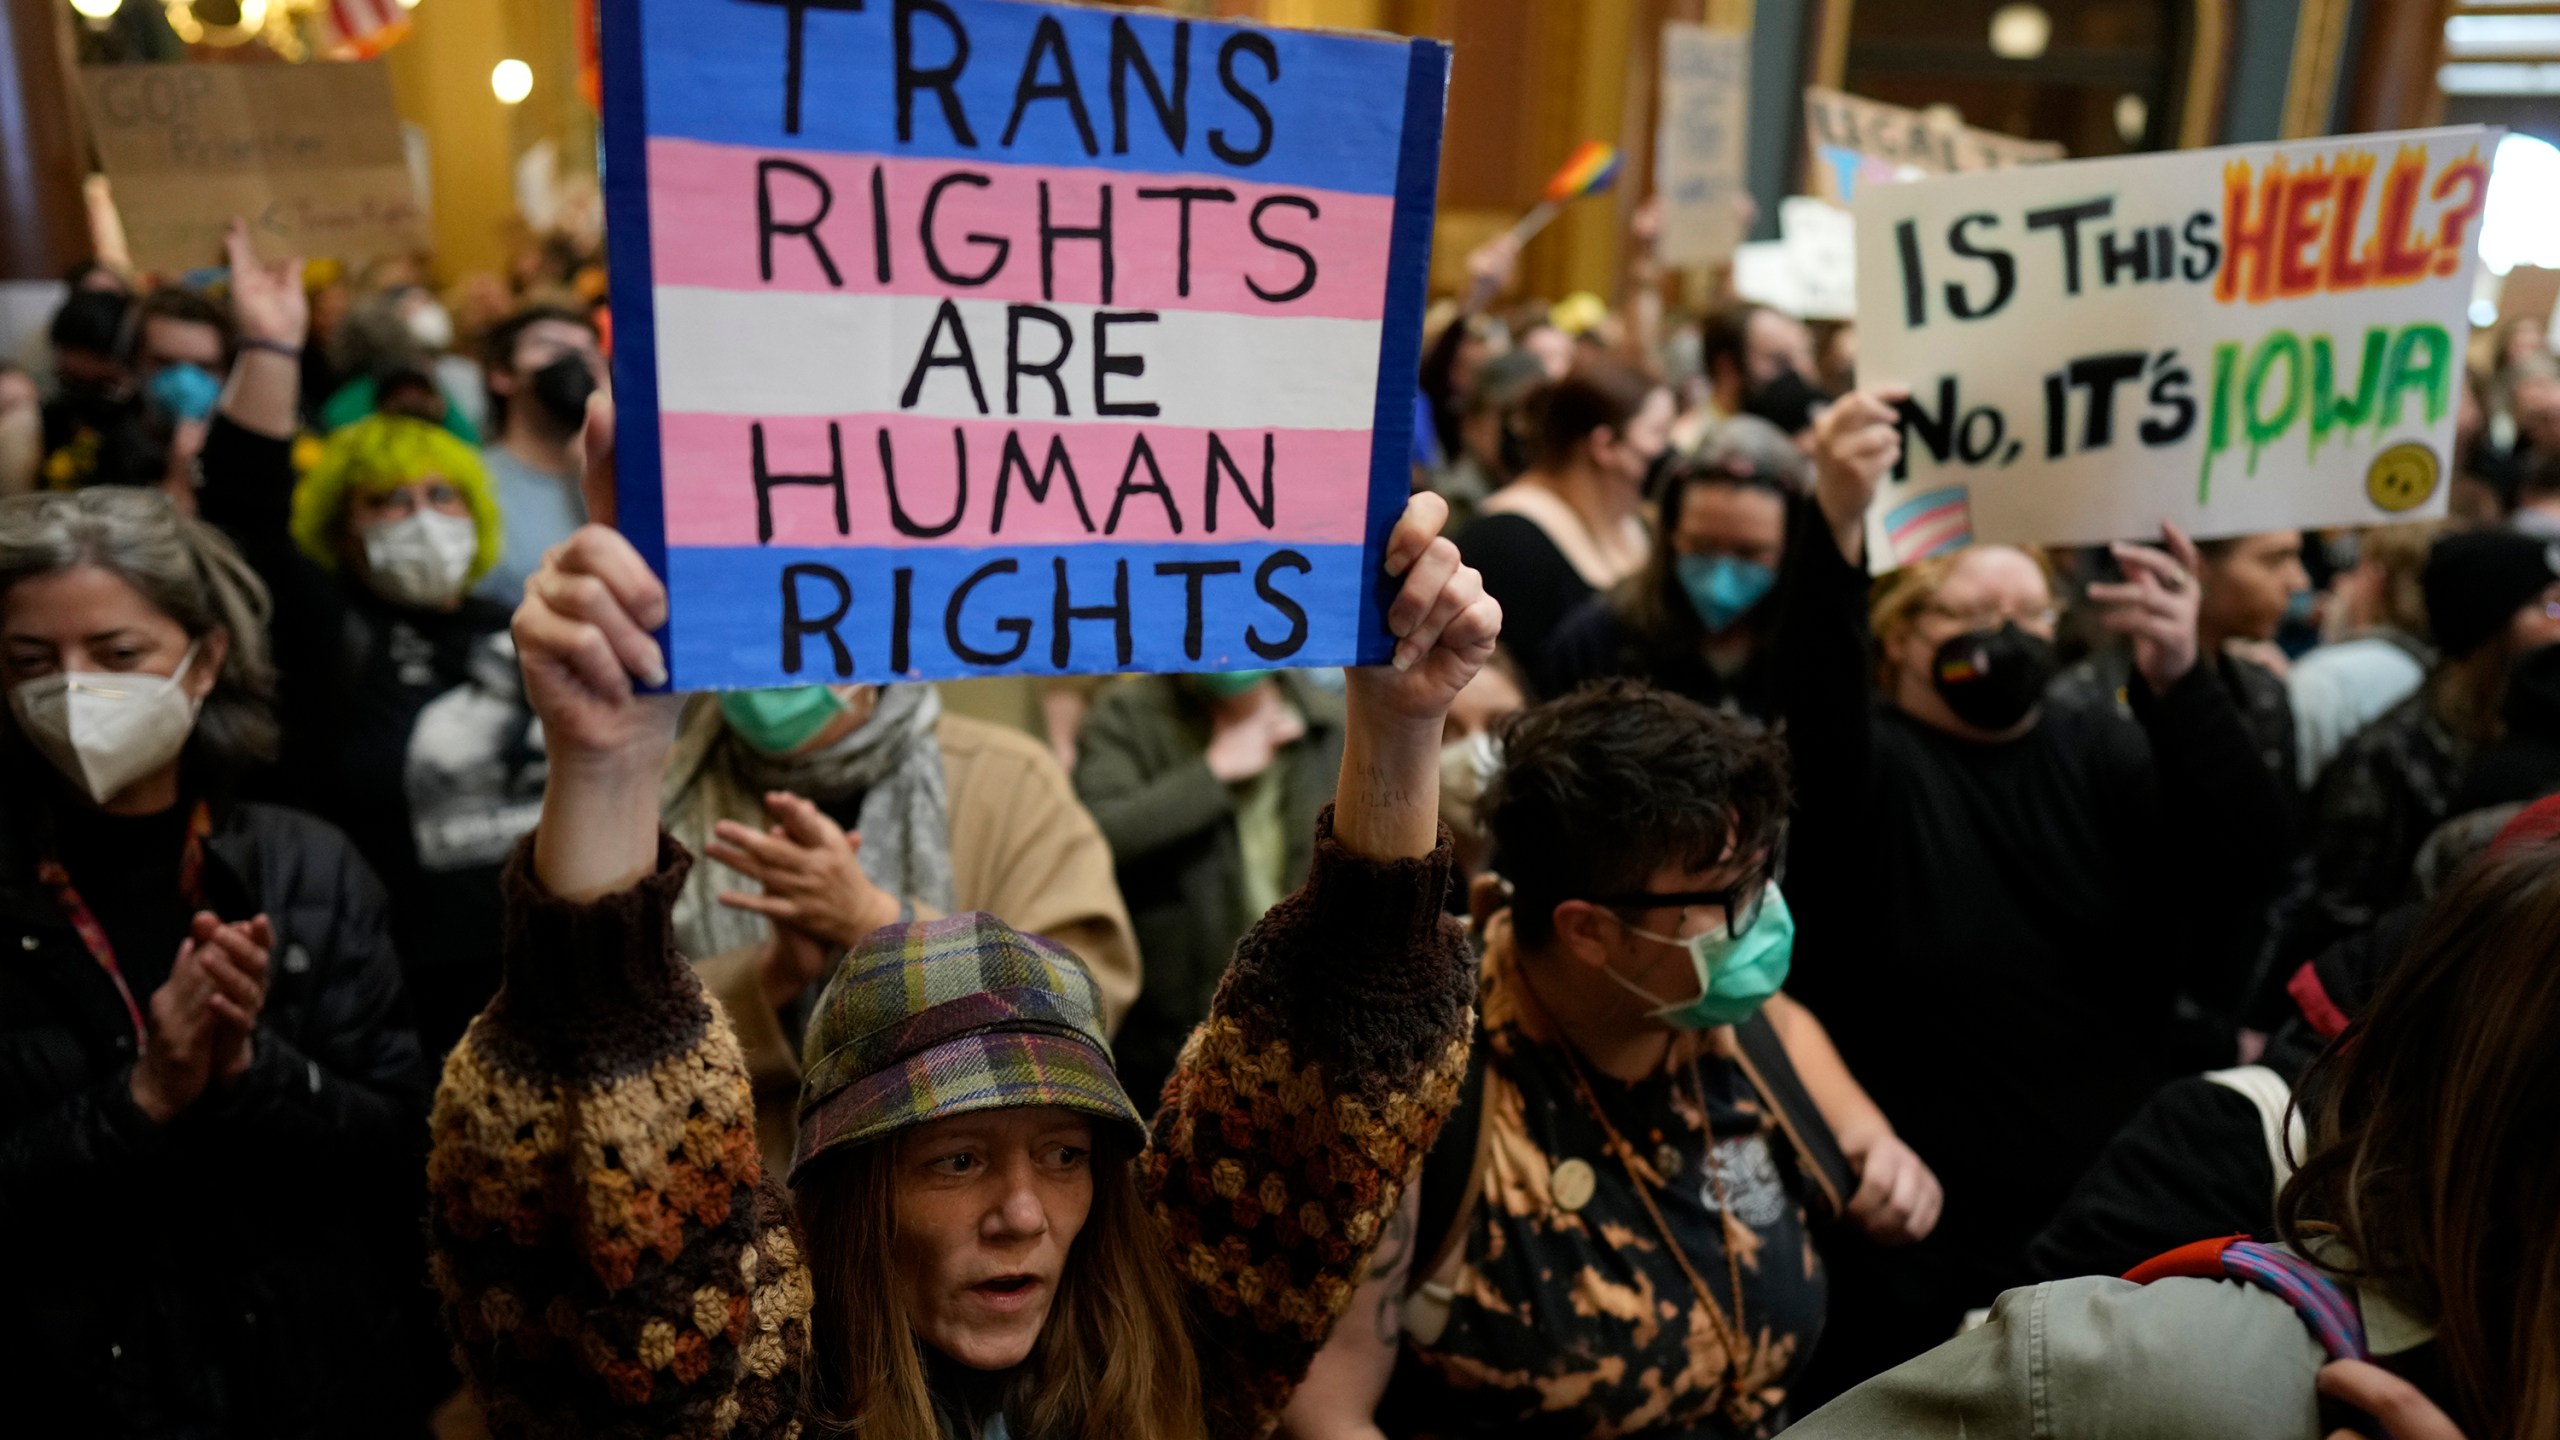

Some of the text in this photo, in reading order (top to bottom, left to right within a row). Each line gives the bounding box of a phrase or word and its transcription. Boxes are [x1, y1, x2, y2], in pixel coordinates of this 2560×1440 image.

[726, 0, 1280, 167] TRANS
[755, 159, 1321, 303] RIGHTS
[1894, 214, 2017, 330] IS
[2213, 143, 2489, 308] HELL?
[900, 299, 1161, 416] ARE
[2197, 322, 2453, 503] IOWA
[751, 422, 1277, 545] HUMAN
[780, 550, 1313, 678] RIGHTS
